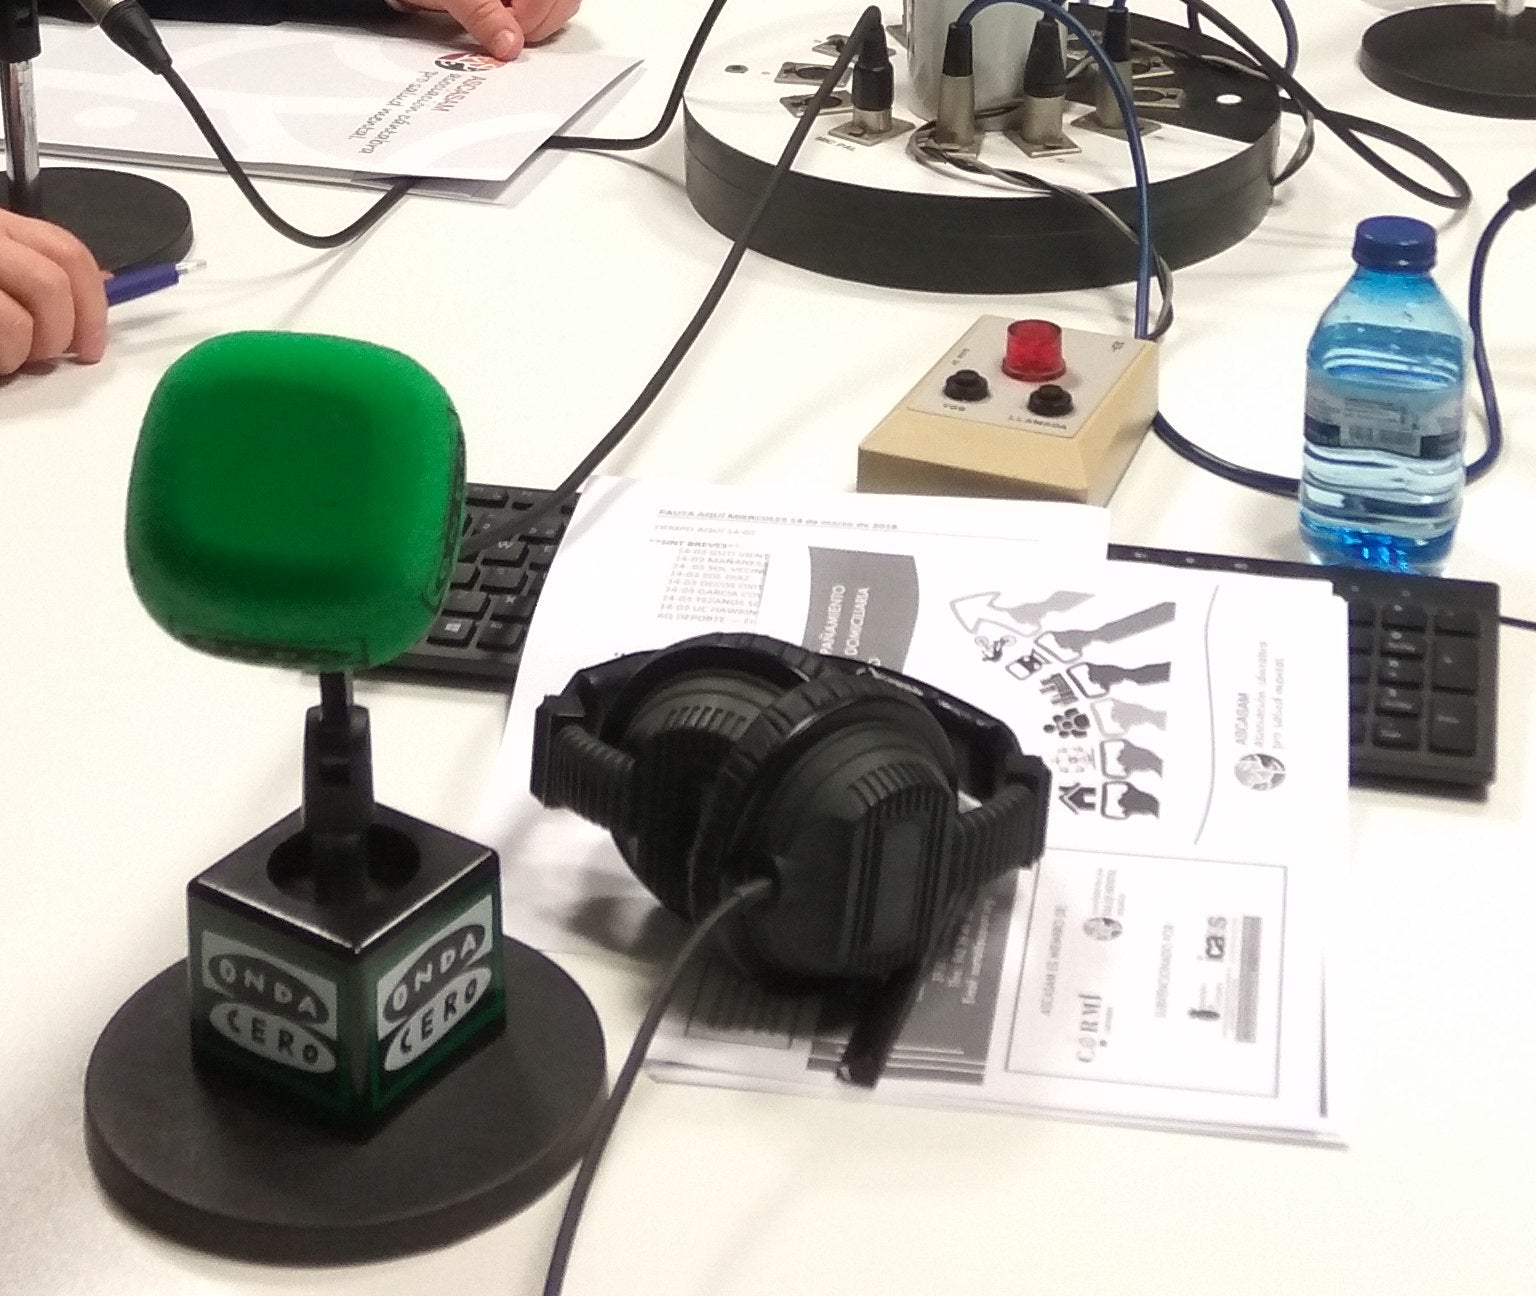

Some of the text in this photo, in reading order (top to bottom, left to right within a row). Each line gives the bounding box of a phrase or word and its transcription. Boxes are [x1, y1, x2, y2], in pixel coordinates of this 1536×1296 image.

[818, 585, 845, 656] PAÑAMIENTO
[220, 958, 319, 1018] ONDA
[391, 934, 480, 1012] ONDA
[227, 1010, 320, 1065] CERO
[399, 977, 480, 1054] CERO
